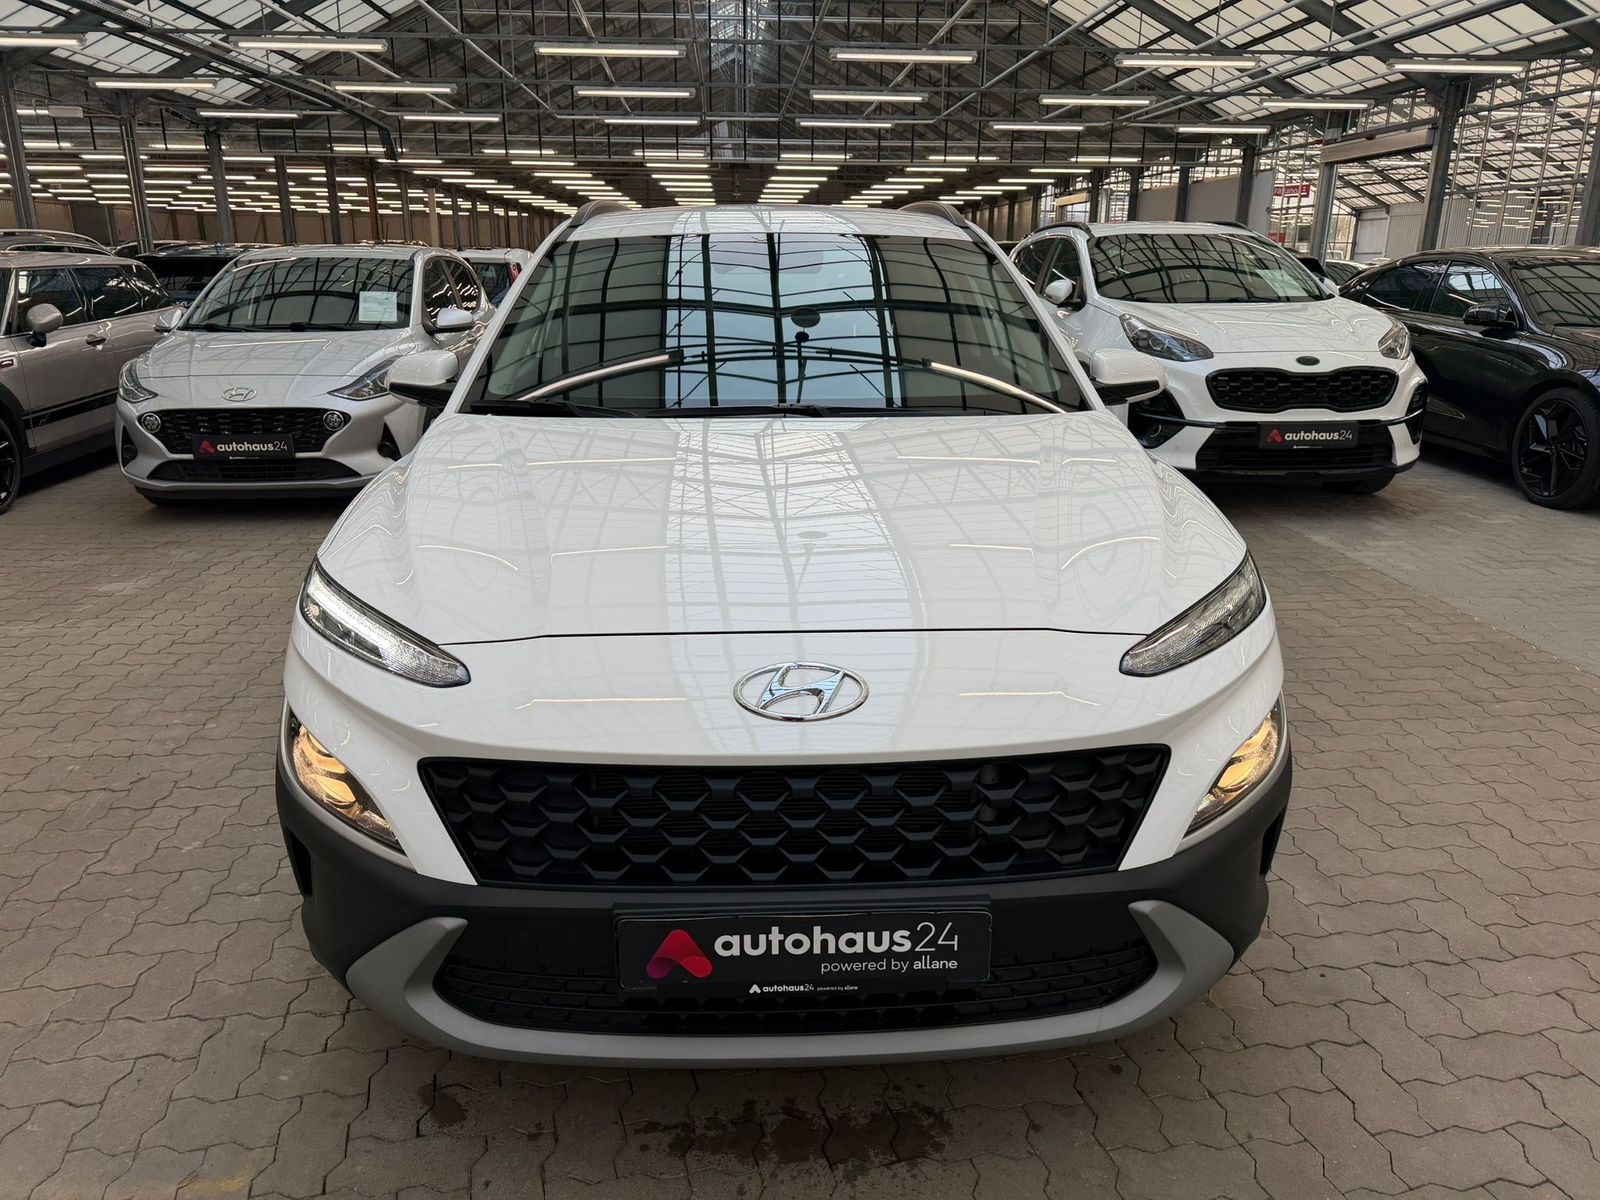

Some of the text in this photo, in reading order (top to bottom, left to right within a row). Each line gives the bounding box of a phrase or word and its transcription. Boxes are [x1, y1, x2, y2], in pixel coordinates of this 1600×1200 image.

[1284, 429, 1352, 441] autohaus24
[216, 440, 288, 451] autohaus24
[713, 921, 958, 957] autohaus24
[821, 955, 958, 975] powered by allane
[762, 983, 815, 992] autohaus24
